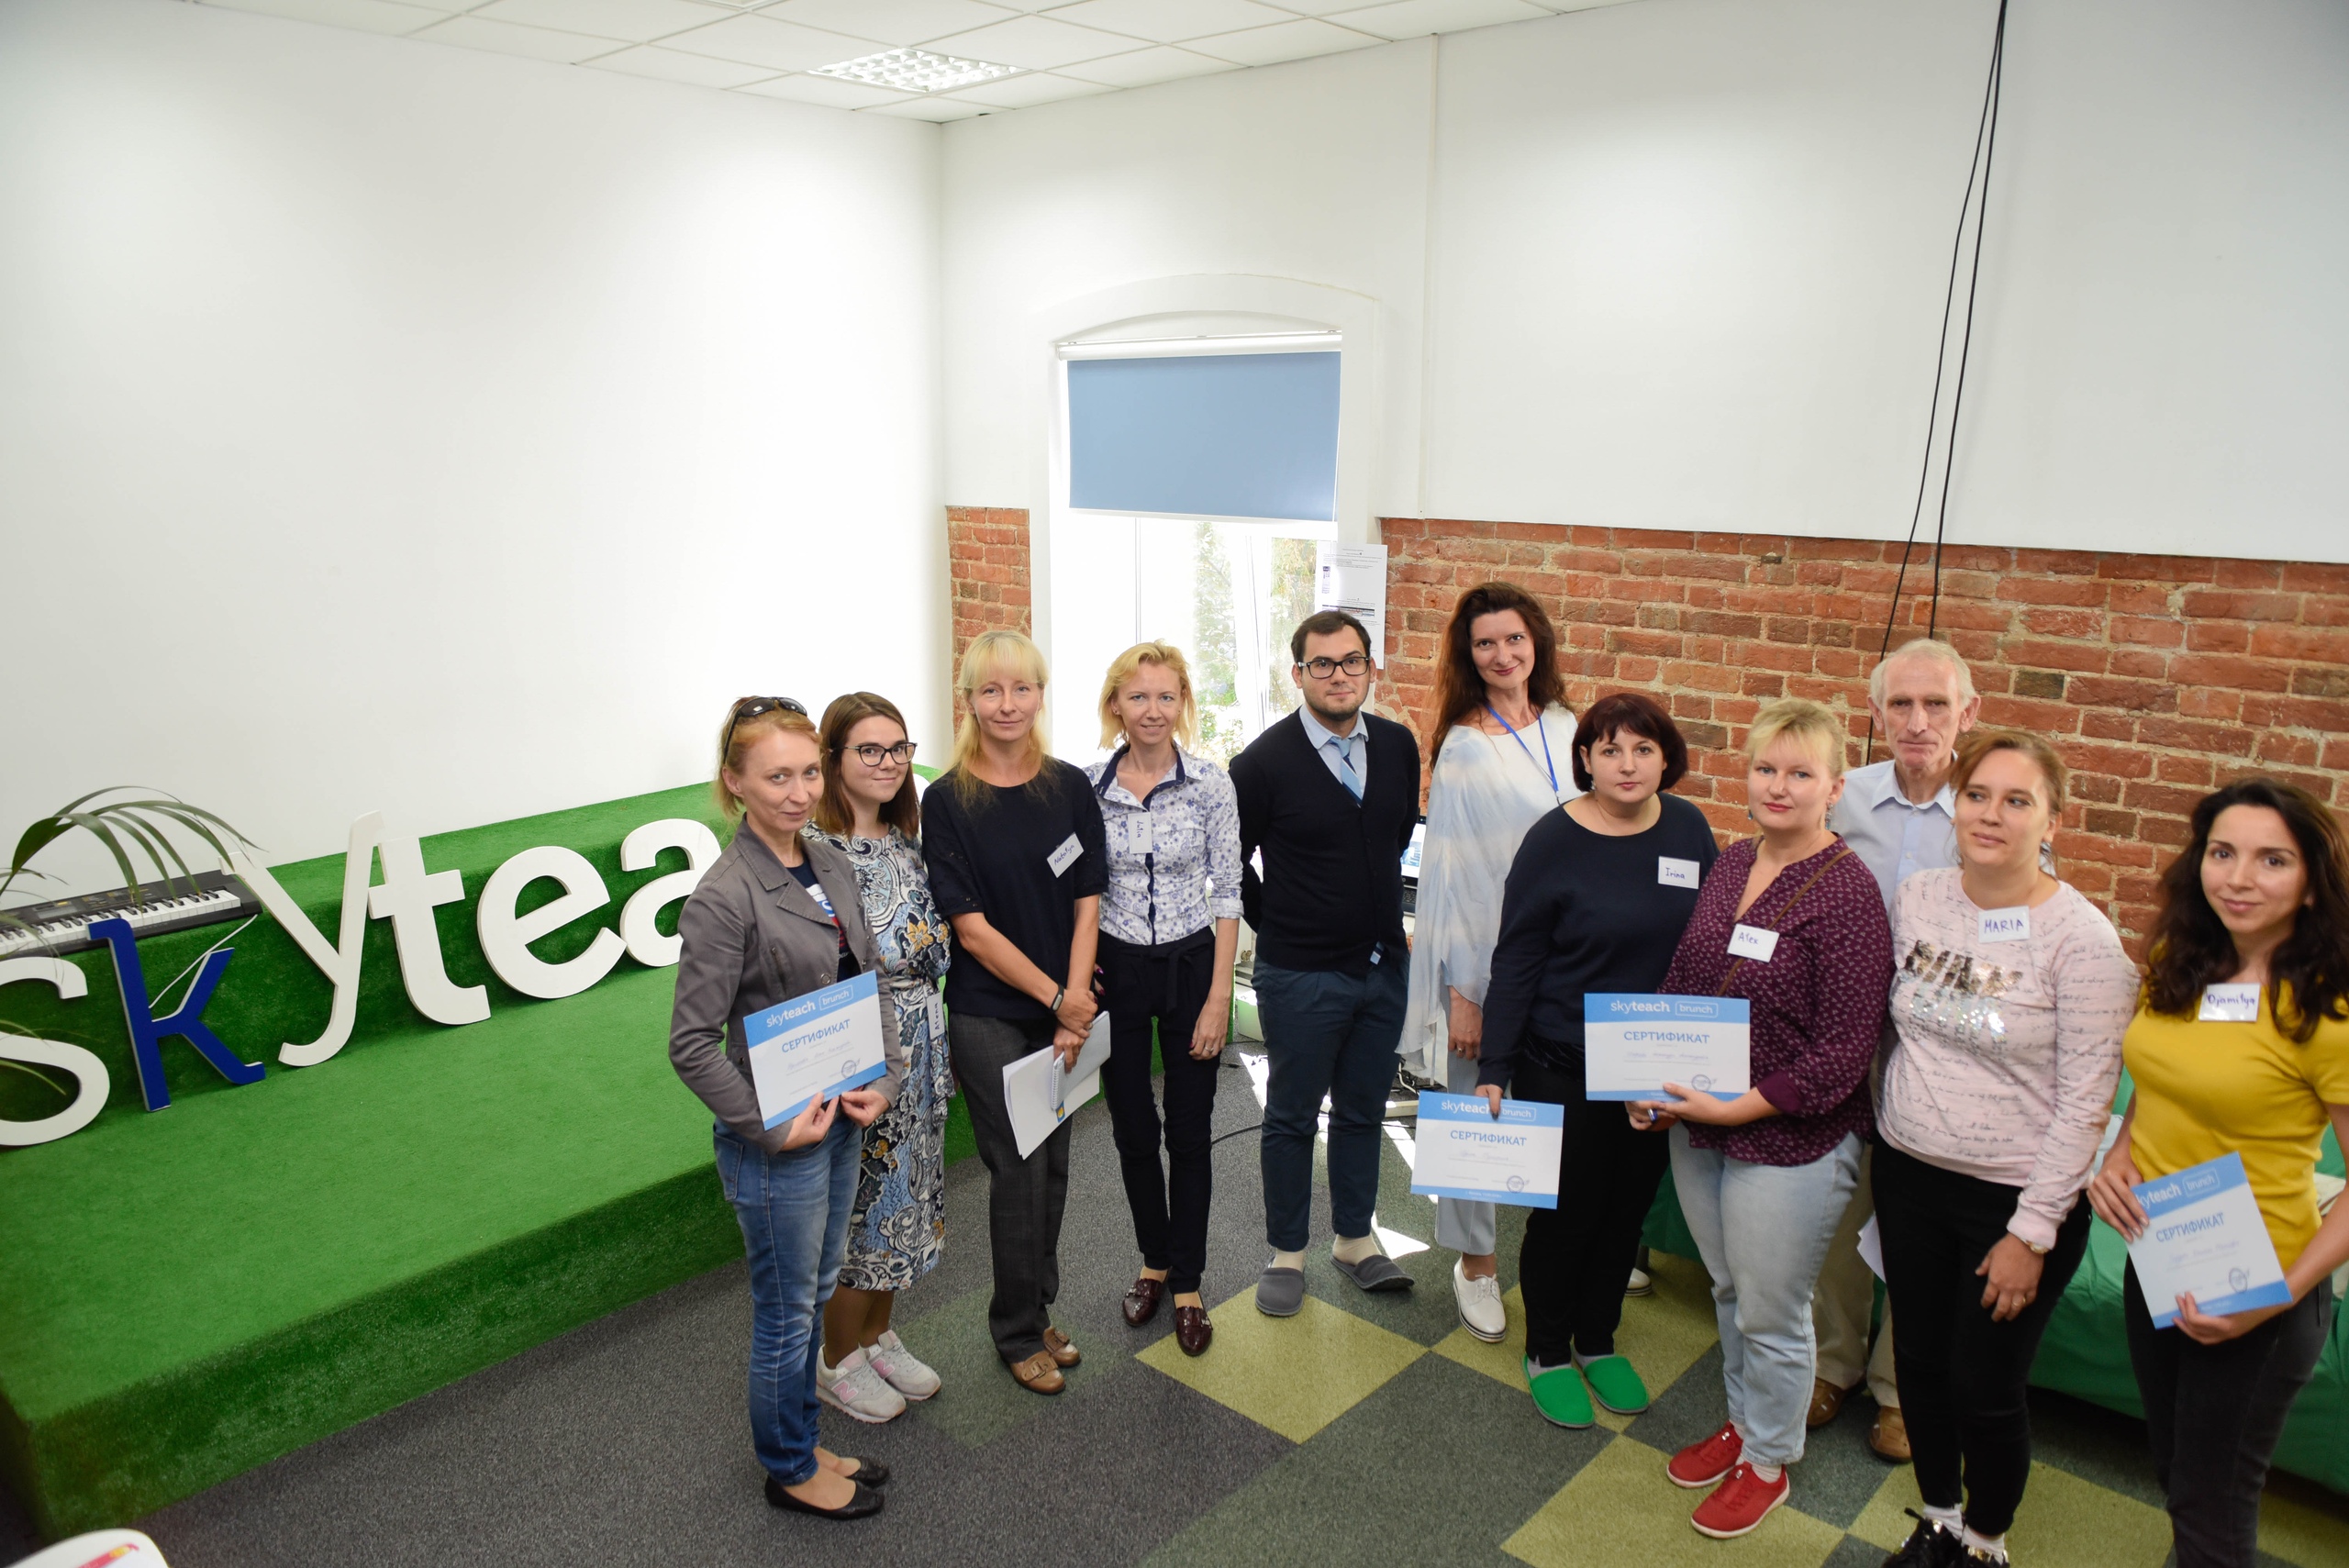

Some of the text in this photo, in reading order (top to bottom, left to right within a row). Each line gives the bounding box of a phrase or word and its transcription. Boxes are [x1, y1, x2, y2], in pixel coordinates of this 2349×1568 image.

[1665, 867, 1686, 879] Irina
[1984, 918, 2024, 934] MARIA
[1738, 931, 1759, 945] Alex
[766, 989, 850, 1029] skyteach brunch
[1610, 1000, 1713, 1014] skyteach brunch
[782, 1018, 851, 1053] СЕРТИФИКАТ
[1623, 1030, 1710, 1044] СЕРТИФИКАТ
[1502, 1107, 1531, 1118] brunch
[1450, 1129, 1527, 1147] СЕРТИФИКАТ
[2135, 1174, 2215, 1209] kyteach brunch
[2156, 1212, 2225, 1242] СЕРТИФИКАТ
